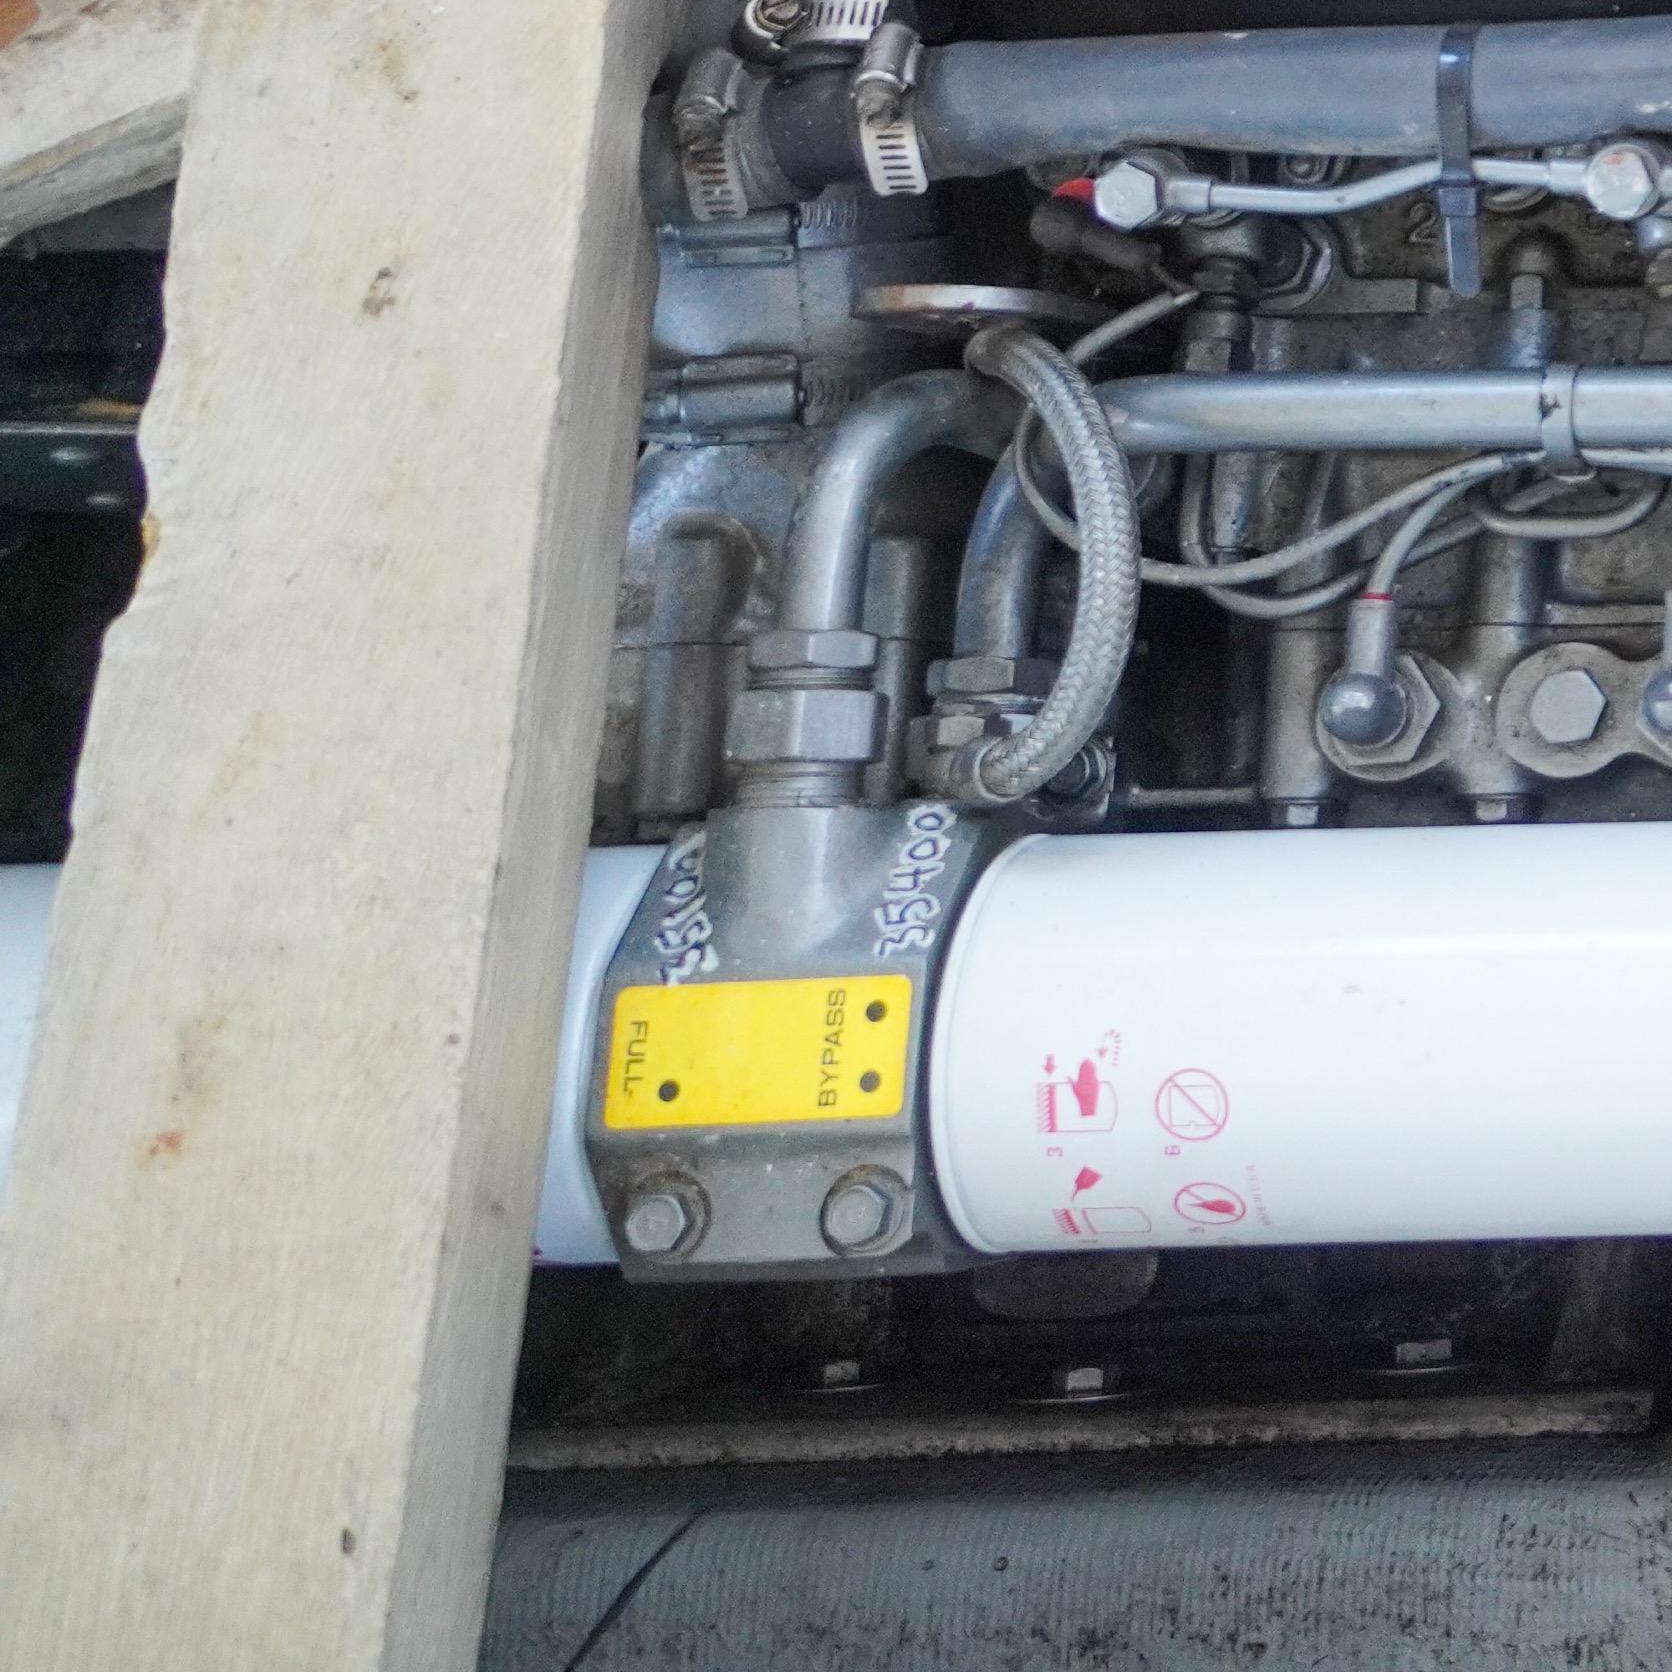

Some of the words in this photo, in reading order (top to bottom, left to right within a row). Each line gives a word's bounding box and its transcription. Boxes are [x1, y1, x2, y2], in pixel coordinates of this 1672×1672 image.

[873, 804, 957, 959] 35400
[622, 1019, 649, 1094] FULL
[817, 988, 847, 1108] BYPASS
[1046, 1146, 1064, 1158] 3
